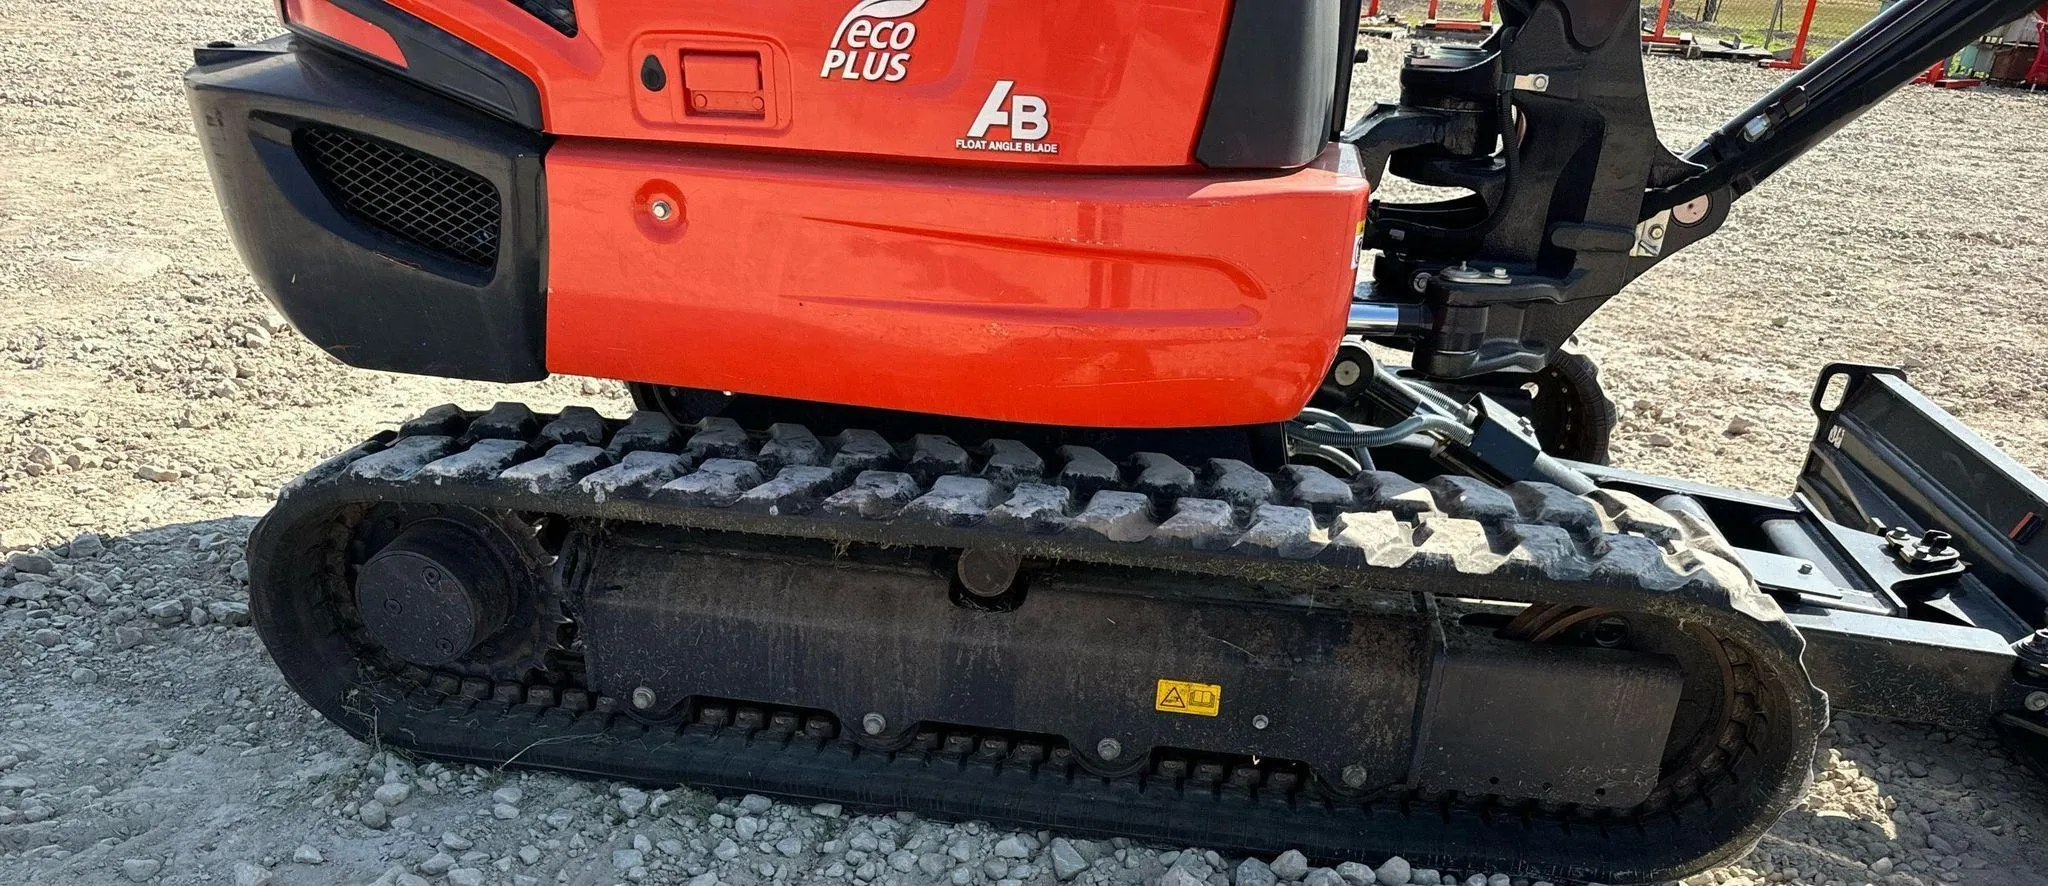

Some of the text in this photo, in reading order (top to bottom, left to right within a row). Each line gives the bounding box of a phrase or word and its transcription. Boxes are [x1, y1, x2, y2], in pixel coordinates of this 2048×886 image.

[846, 19, 916, 50] eco
[820, 49, 911, 82] PLUS
[966, 79, 1049, 140] AB
[955, 139, 1058, 153] FLOAT ANGLE BLADE
